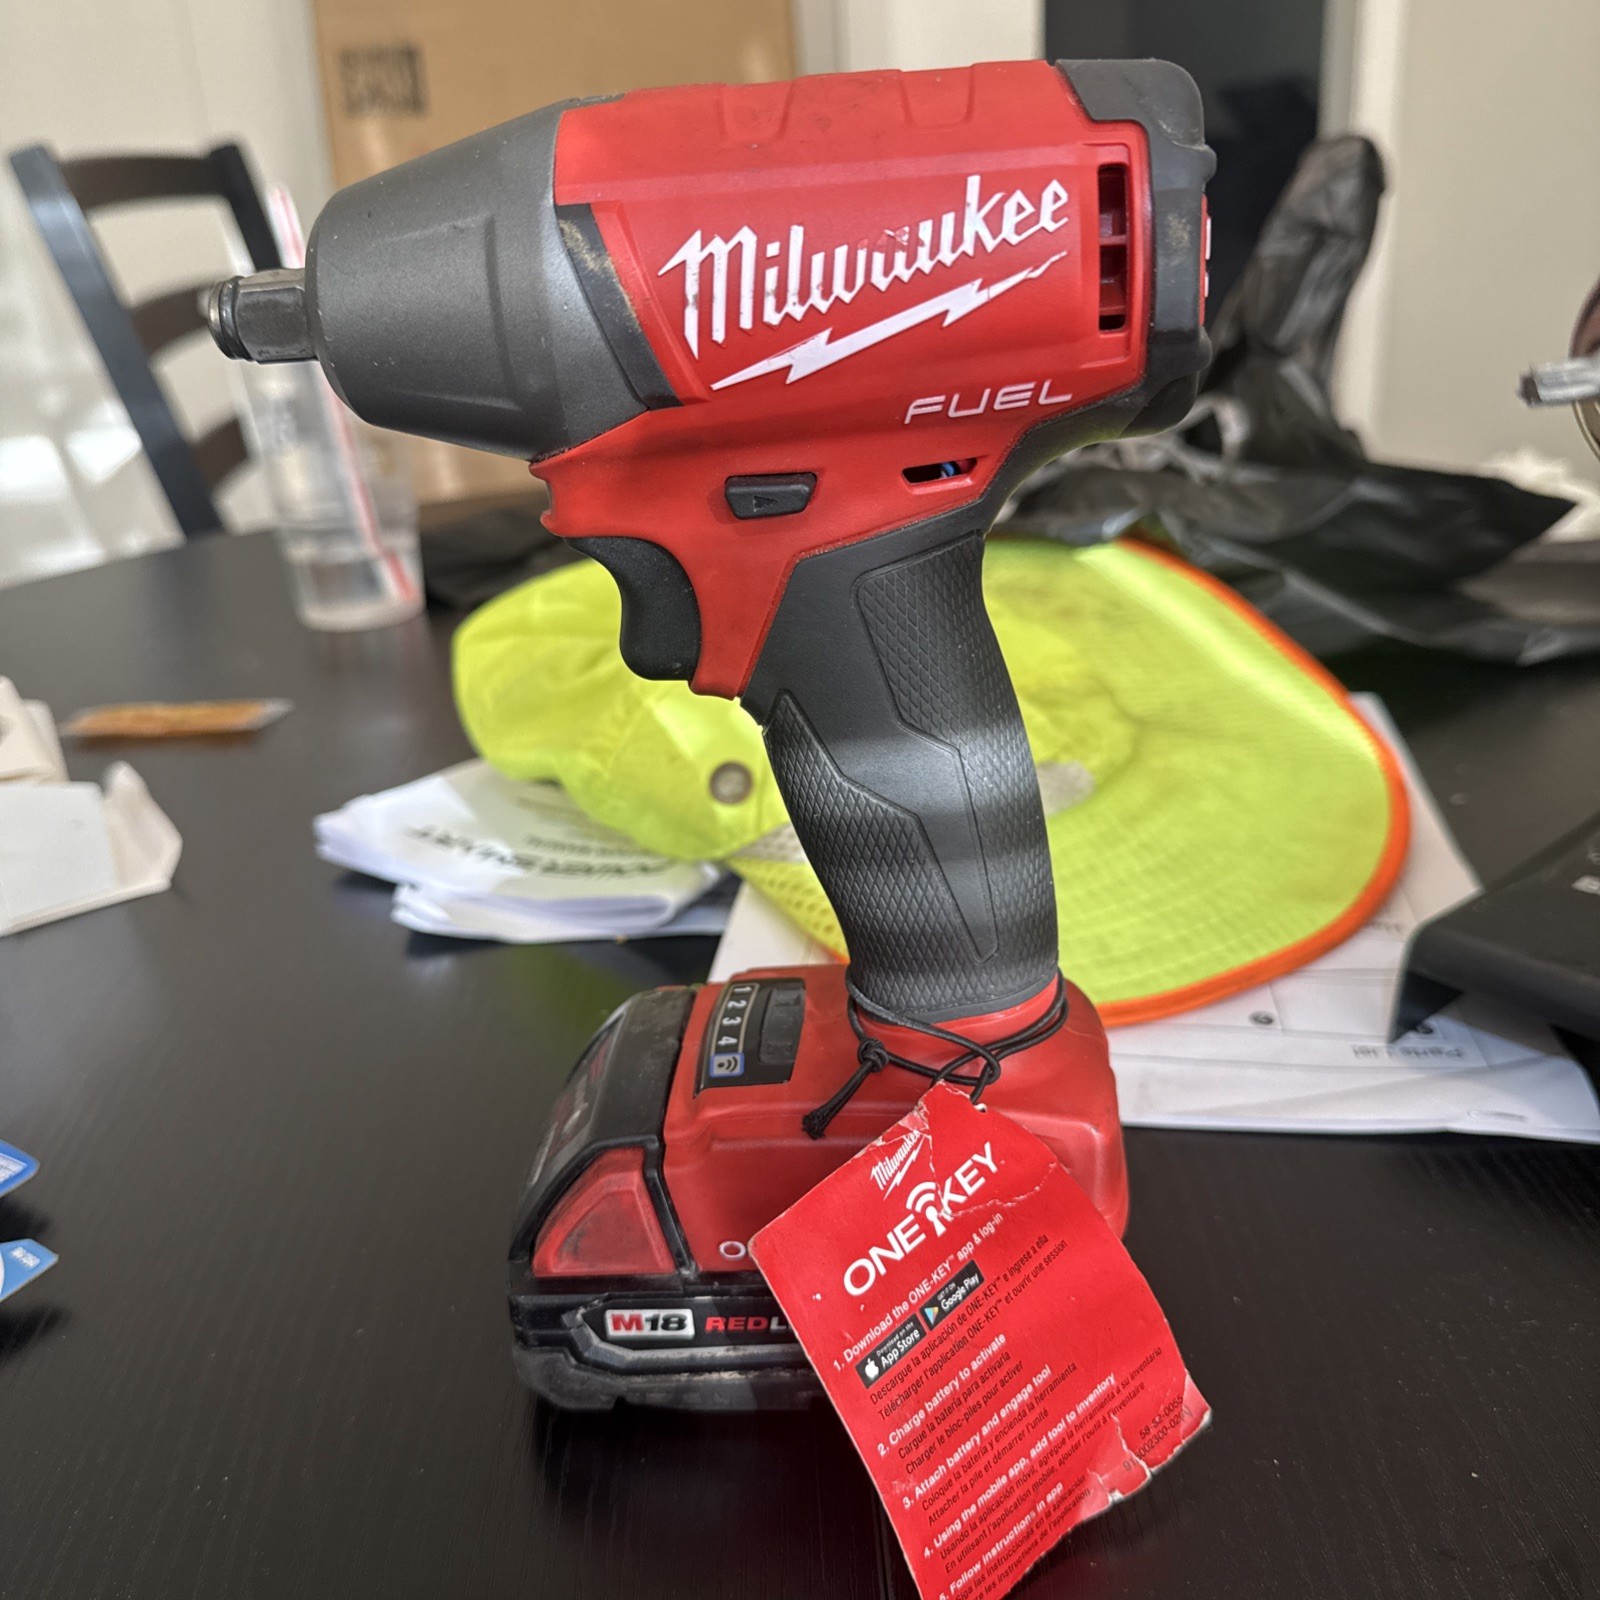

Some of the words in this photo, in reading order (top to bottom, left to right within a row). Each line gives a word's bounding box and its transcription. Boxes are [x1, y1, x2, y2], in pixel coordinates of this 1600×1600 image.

[658, 174, 1069, 360] Milwaukee
[904, 380, 1072, 424] FUEL
[717, 1036, 738, 1046] 4
[722, 1016, 742, 1026] 3
[727, 1000, 747, 1009] 2
[844, 1213, 926, 1296] ONE
[941, 1141, 998, 1222] KEY
[611, 1313, 688, 1332] M18
[705, 1316, 792, 1332] REDL
[832, 1357, 845, 1372] 1.
[842, 1312, 893, 1364] Download
[891, 1298, 909, 1320] the
[956, 1239, 975, 1262] app
[971, 1231, 982, 1245] &
[977, 1210, 1004, 1239] log-in
[868, 1362, 913, 1406] Descargue
[910, 1354, 922, 1368] la
[919, 1320, 958, 1360] aplicación
[955, 1311, 968, 1326] de
[1002, 1272, 1009, 1282] e
[1006, 1249, 1033, 1278] ingrese
[1029, 1244, 1038, 1254] a
[1034, 1232, 1049, 1249] ella
[875, 1331, 900, 1357] Download
[904, 1319, 914, 1331] the
[877, 1373, 925, 1421] Télécharger
[1003, 1290, 1014, 1304] et
[1011, 1273, 1032, 1297] ouvrir
[1030, 1261, 1045, 1278] une
[1042, 1238, 1068, 1266] session
[879, 1346, 900, 1370] App
[895, 1327, 920, 1353] Store
[940, 1284, 967, 1313] Google
[962, 1271, 980, 1291] Play
[876, 1441, 889, 1457] 2.
[887, 1407, 926, 1446] Charge
[923, 1375, 960, 1414] battery
[958, 1365, 970, 1381] to
[969, 1332, 1006, 1371] activate
[897, 1428, 927, 1460] Cargue
[925, 1420, 936, 1433] la
[933, 1395, 963, 1426] batería
[960, 1380, 980, 1403] para
[978, 1350, 1011, 1384] activarla
[902, 1494, 914, 1509] 3.
[913, 1463, 947, 1499] Attach
[945, 1430, 981, 1470] battery
[979, 1412, 1000, 1436] and
[998, 1382, 1034, 1420] engage
[1031, 1363, 1051, 1387] tool
[904, 1440, 938, 1476] Charger
[935, 1433, 945, 1446] le
[943, 1398, 982, 1439] bloc-piles
[981, 1382, 1000, 1406] pour
[998, 1359, 1024, 1388] activer
[921, 1477, 954, 1512] Coloque
[951, 1469, 962, 1482] la
[960, 1443, 989, 1473] batería
[987, 1438, 995, 1451] y
[993, 1407, 1028, 1443] encienda
[1025, 1400, 1035, 1413] la
[1033, 1360, 1077, 1405] herramienta
[939, 1527, 970, 1560] Usando
[968, 1520, 978, 1532] la
[976, 1484, 1015, 1525] aplicación
[1014, 1463, 1038, 1489] móvil,
[1037, 1435, 1067, 1469] agregue
[1065, 1428, 1074, 1440] la
[1073, 1389, 1116, 1433] herramienta
[1114, 1384, 1121, 1395] a
[1120, 1376, 1130, 1389] su
[1128, 1345, 1162, 1380] inventario
[922, 1545, 933, 1558] 4.
[932, 1516, 962, 1549] Using
[960, 1502, 977, 1522] the
[975, 1473, 1008, 1507] mobile
[1028, 1434, 1048, 1459] add
[1046, 1417, 1066, 1441] tool
[1064, 1409, 1077, 1424] to
[1075, 1371, 1116, 1415] inventory
[927, 1490, 961, 1526] Attacher
[959, 1482, 969, 1495] la
[968, 1468, 984, 1489] pile
[982, 1459, 992, 1473] et
[991, 1428, 1026, 1465] démarrer
[944, 1558, 957, 1574] En
[955, 1528, 988, 1563] utilisant
[1030, 1464, 1058, 1493] mobile,
[1056, 1438, 1082, 1467] ajouter
[948, 1559, 982, 1595] Follow
[981, 1509, 1036, 1565] instructions
[1035, 1498, 1046, 1513] in
[1044, 1480, 1064, 1504] app
[972, 1572, 986, 1589] las
[984, 1524, 1035, 1577] instrucciones
[1034, 1515, 1044, 1529] en
[1043, 1507, 1052, 1520] la
[1050, 1473, 1087, 1512] aplicación
[983, 1579, 997, 1595] les
[995, 1538, 1039, 1583] instructions
[1038, 1527, 1048, 1542] de
